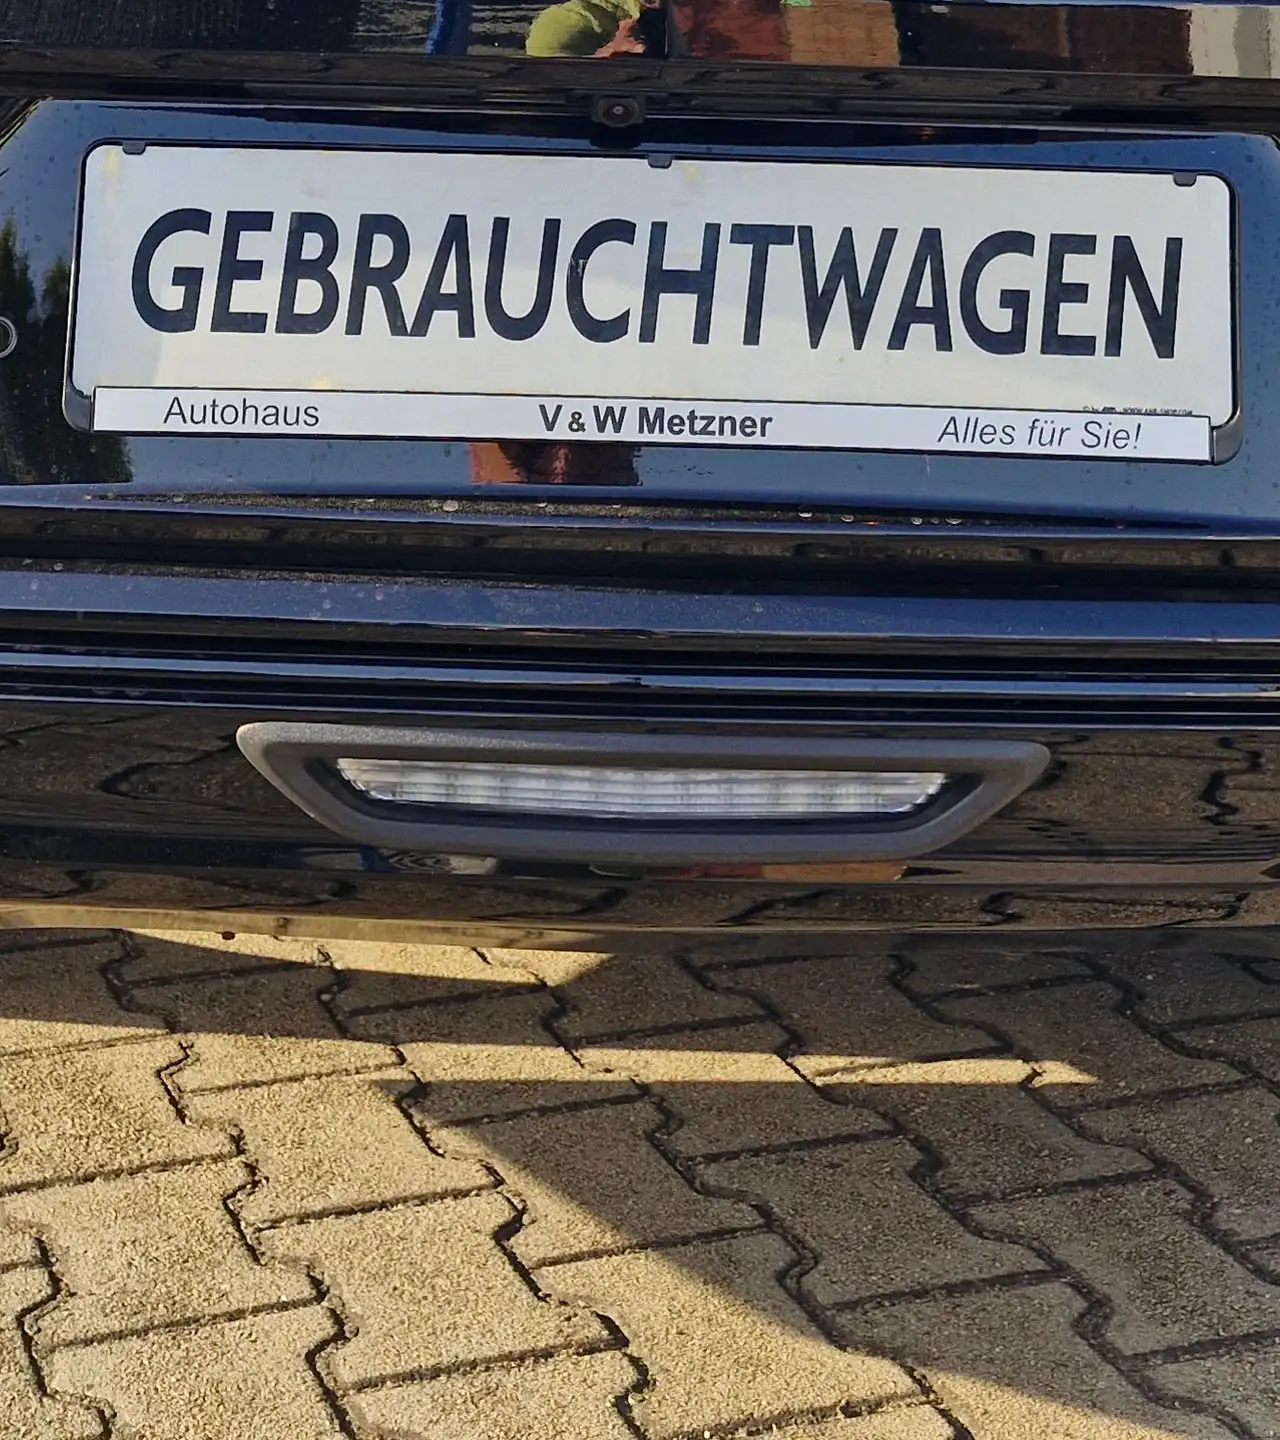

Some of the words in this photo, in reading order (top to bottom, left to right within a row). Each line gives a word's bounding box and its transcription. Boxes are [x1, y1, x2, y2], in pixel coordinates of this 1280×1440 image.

[131, 207, 1184, 360] GEBRAUCHTWAGEN
[163, 396, 320, 427] Autohaus
[538, 403, 563, 432] V
[567, 410, 587, 433] &
[592, 405, 627, 434] W
[637, 406, 774, 437] Metzner
[937, 416, 1016, 446] Alles
[1027, 418, 1071, 447] für
[1081, 420, 1142, 450] Sie!
